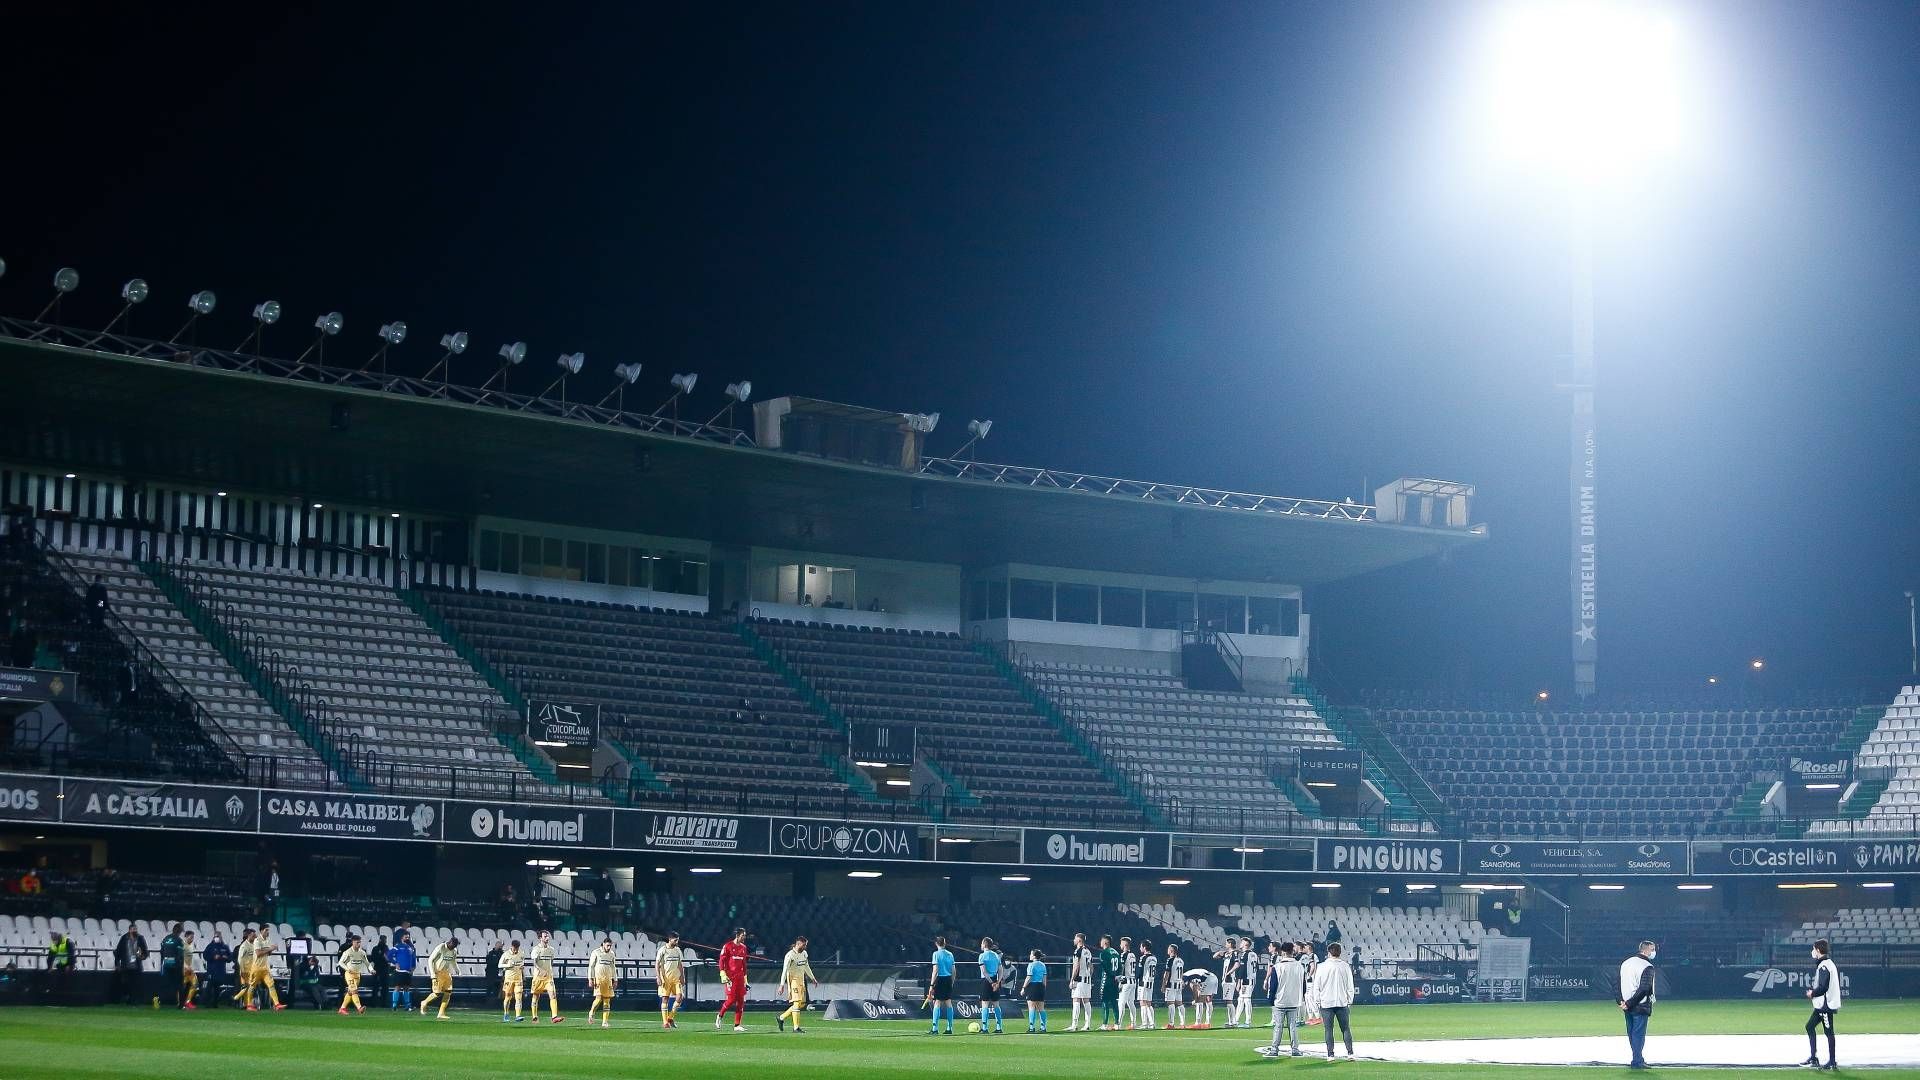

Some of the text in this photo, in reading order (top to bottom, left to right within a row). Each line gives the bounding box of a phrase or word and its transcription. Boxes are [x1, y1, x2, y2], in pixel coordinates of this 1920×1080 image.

[1581, 486, 1595, 537] DAMM
[1581, 543, 1595, 620] ESTRELLA
[1802, 759, 1849, 773] Rosell
[86, 793, 208, 819] A CASTALIA
[267, 798, 409, 822] CASA MARIBEL
[300, 822, 334, 831] ASADOR
[498, 809, 585, 842] hummel
[1069, 834, 1145, 863] hummel
[1333, 841, 1443, 872] PINGÜINS
[1873, 844, 1904, 867] PAM
[1382, 984, 1411, 997] LaLiga
[1432, 984, 1460, 996] LaLiga
[1544, 978, 1590, 987] BENASSAL
[1788, 971, 1850, 988] Pith
[879, 1003, 906, 1016] Marzá
